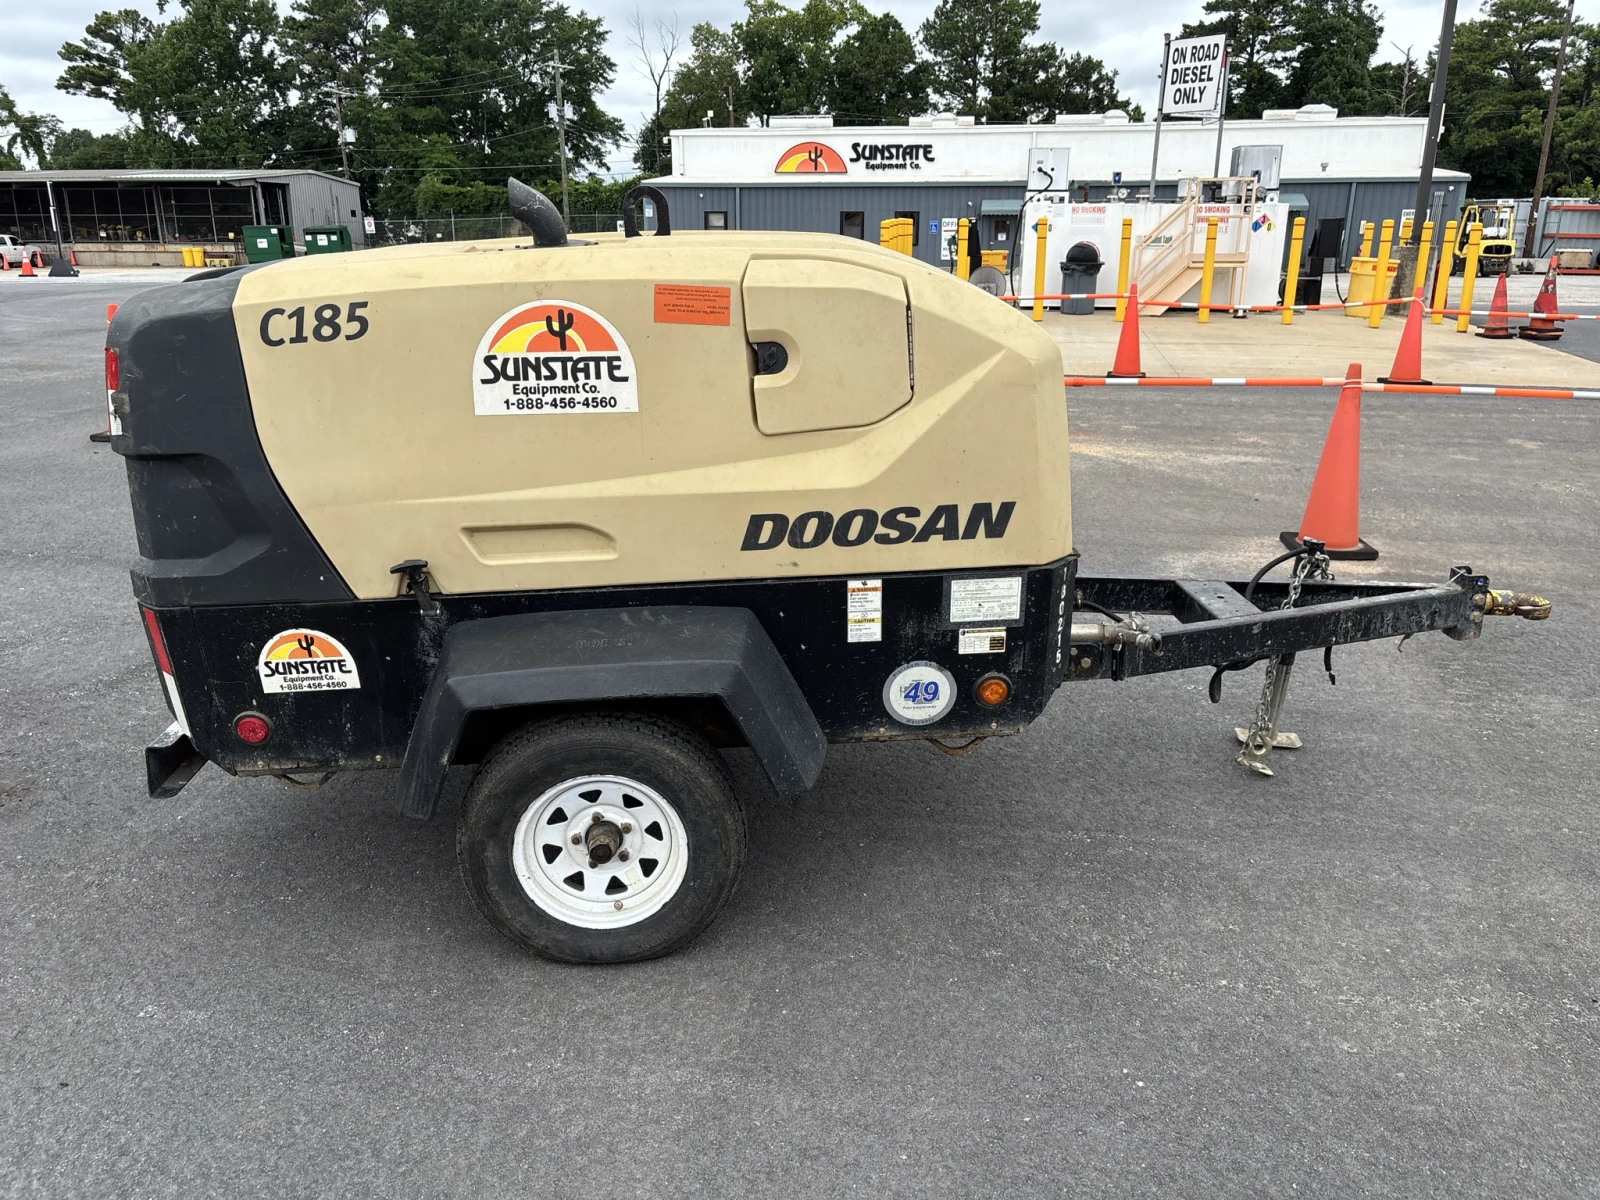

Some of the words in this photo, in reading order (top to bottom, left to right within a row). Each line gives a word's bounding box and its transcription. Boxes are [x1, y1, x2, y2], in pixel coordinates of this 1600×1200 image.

[1172, 47, 1188, 65] ON
[1190, 43, 1219, 63] ROAD
[1171, 65, 1214, 85] DIESEL
[1173, 86, 1207, 105] ONLY
[849, 142, 936, 162] SUNSTATE
[865, 162, 907, 171] Equipment
[909, 162, 921, 170] Co.
[1072, 206, 1080, 214] NO
[1081, 206, 1106, 214] SMOKING
[1204, 206, 1230, 214] SMOKING
[1261, 215, 1266, 224] 3
[260, 301, 369, 347] C185
[480, 354, 629, 385] SUNSTATE
[513, 383, 580, 397] Equipment
[582, 382, 600, 394] Co.
[504, 396, 617, 410] 1-888-456-4560
[740, 501, 1017, 551] DOOSAN
[263, 659, 352, 678] SUNSTATE
[280, 681, 347, 691] 1-888-456-4560
[283, 674, 324, 683] Equipment
[903, 681, 939, 703] 49
